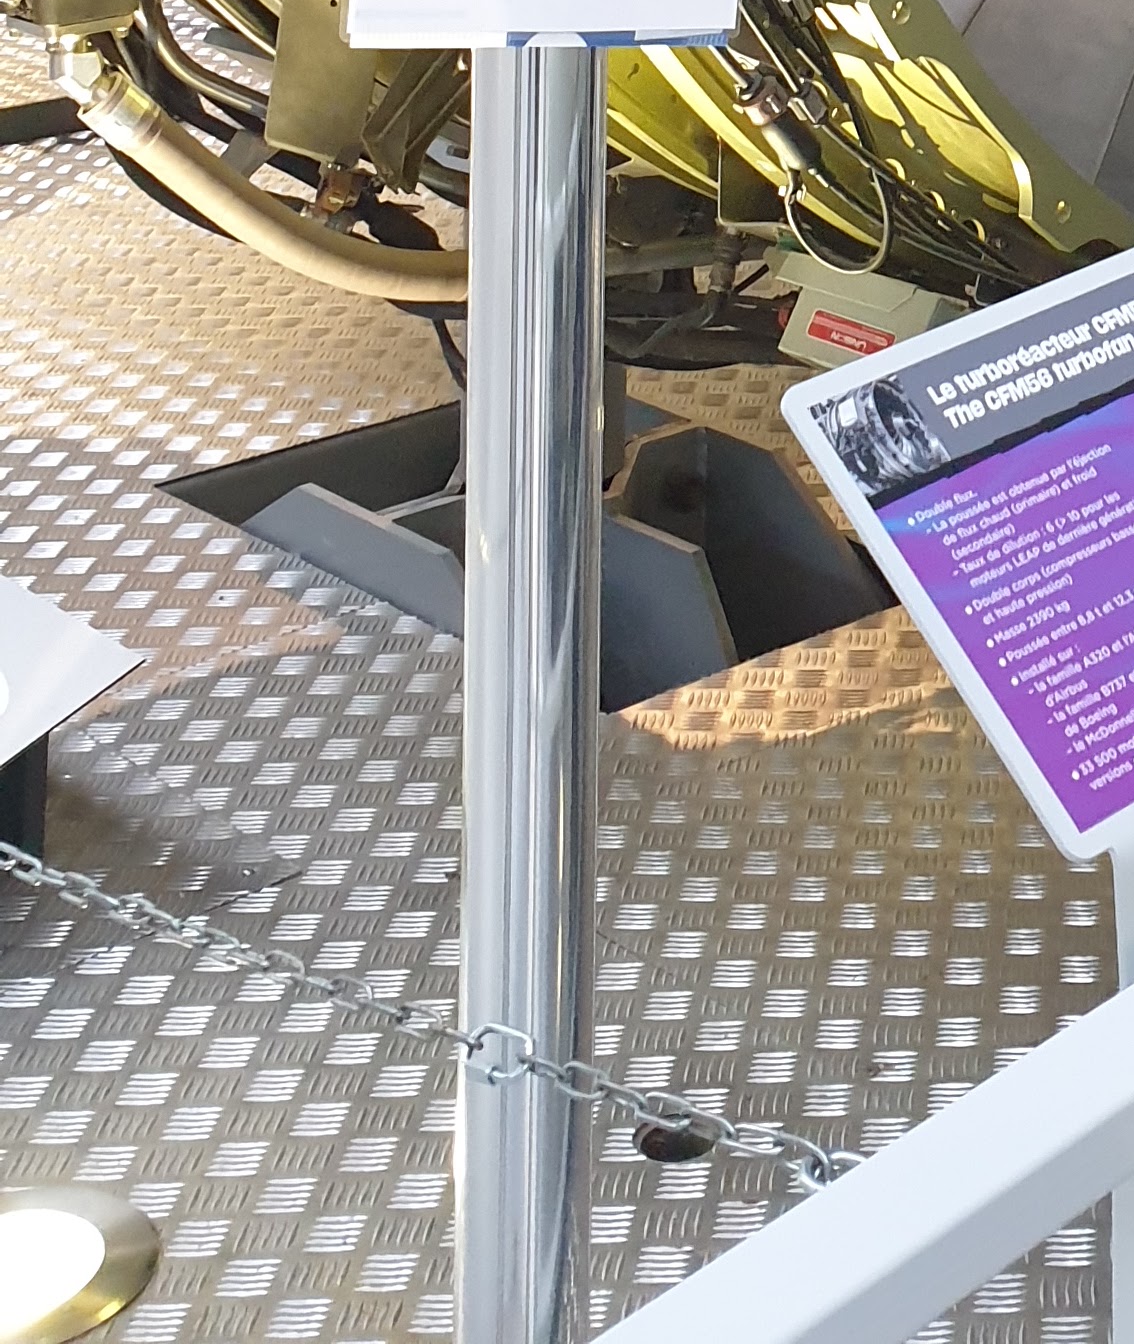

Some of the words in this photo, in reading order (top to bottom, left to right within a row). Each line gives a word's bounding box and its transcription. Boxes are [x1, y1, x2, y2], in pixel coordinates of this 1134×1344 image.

[926, 381, 957, 406] Le
[953, 322, 1092, 394] turboréacteur
[942, 398, 986, 429] The
[984, 367, 1054, 411] CFM56
[914, 499, 954, 523] Double
[931, 519, 948, 532] La
[947, 500, 991, 527] poussée
[991, 491, 1009, 505] est
[1008, 472, 1050, 498] obtenue
[1049, 464, 1067, 480] par
[1065, 444, 1112, 470] l'éjection
[942, 533, 957, 546] de
[956, 523, 979, 538] flux
[979, 505, 1011, 529] chaud
[1010, 483, 1061, 514] (primaire)
[1060, 478, 1073, 490] et
[1071, 465, 1097, 485] froid
[951, 522, 1016, 560] (secondaire)
[958, 556, 986, 574] Taux
[986, 548, 1001, 562] de
[1001, 529, 1041, 555] dilution
[1045, 521, 1055, 533] 6
[1066, 509, 1081, 522] 10
[1080, 498, 1104, 518] pour
[1103, 491, 1121, 505] les
[969, 561, 1013, 588] moteurs
[1011, 546, 1040, 568] LEAP
[1042, 540, 1057, 553] de
[1056, 520, 1098, 546] dernière
[971, 586, 1011, 611] Double
[1011, 571, 1041, 592] corps
[1040, 536, 1113, 578] (compresseurs
[982, 612, 995, 625] et
[993, 597, 1026, 619] haute
[1025, 572, 1073, 605] pression)
[993, 622, 1027, 644] Masse
[1026, 606, 1055, 628] 2390
[1053, 600, 1071, 613] kg
[1005, 635, 1050, 662] Poussée
[1050, 620, 1078, 641] entre
[1102, 600, 1115, 614] et
[1017, 654, 1057, 682] Installé
[1057, 646, 1074, 662] sur
[1033, 680, 1047, 693] la
[1045, 662, 1082, 686] famille
[1083, 645, 1111, 668] A320
[1111, 639, 1124, 653] et
[1045, 679, 1088, 707] d'Airbus
[1052, 710, 1067, 722] la
[1064, 691, 1101, 716] famille
[1099, 674, 1126, 697] B737
[1064, 723, 1079, 737] de
[1078, 703, 1118, 729] Boeing
[1072, 739, 1086, 753] le
[1078, 759, 1095, 776] 33
[1093, 747, 1117, 767] 500
[1089, 760, 1133, 790] versions
